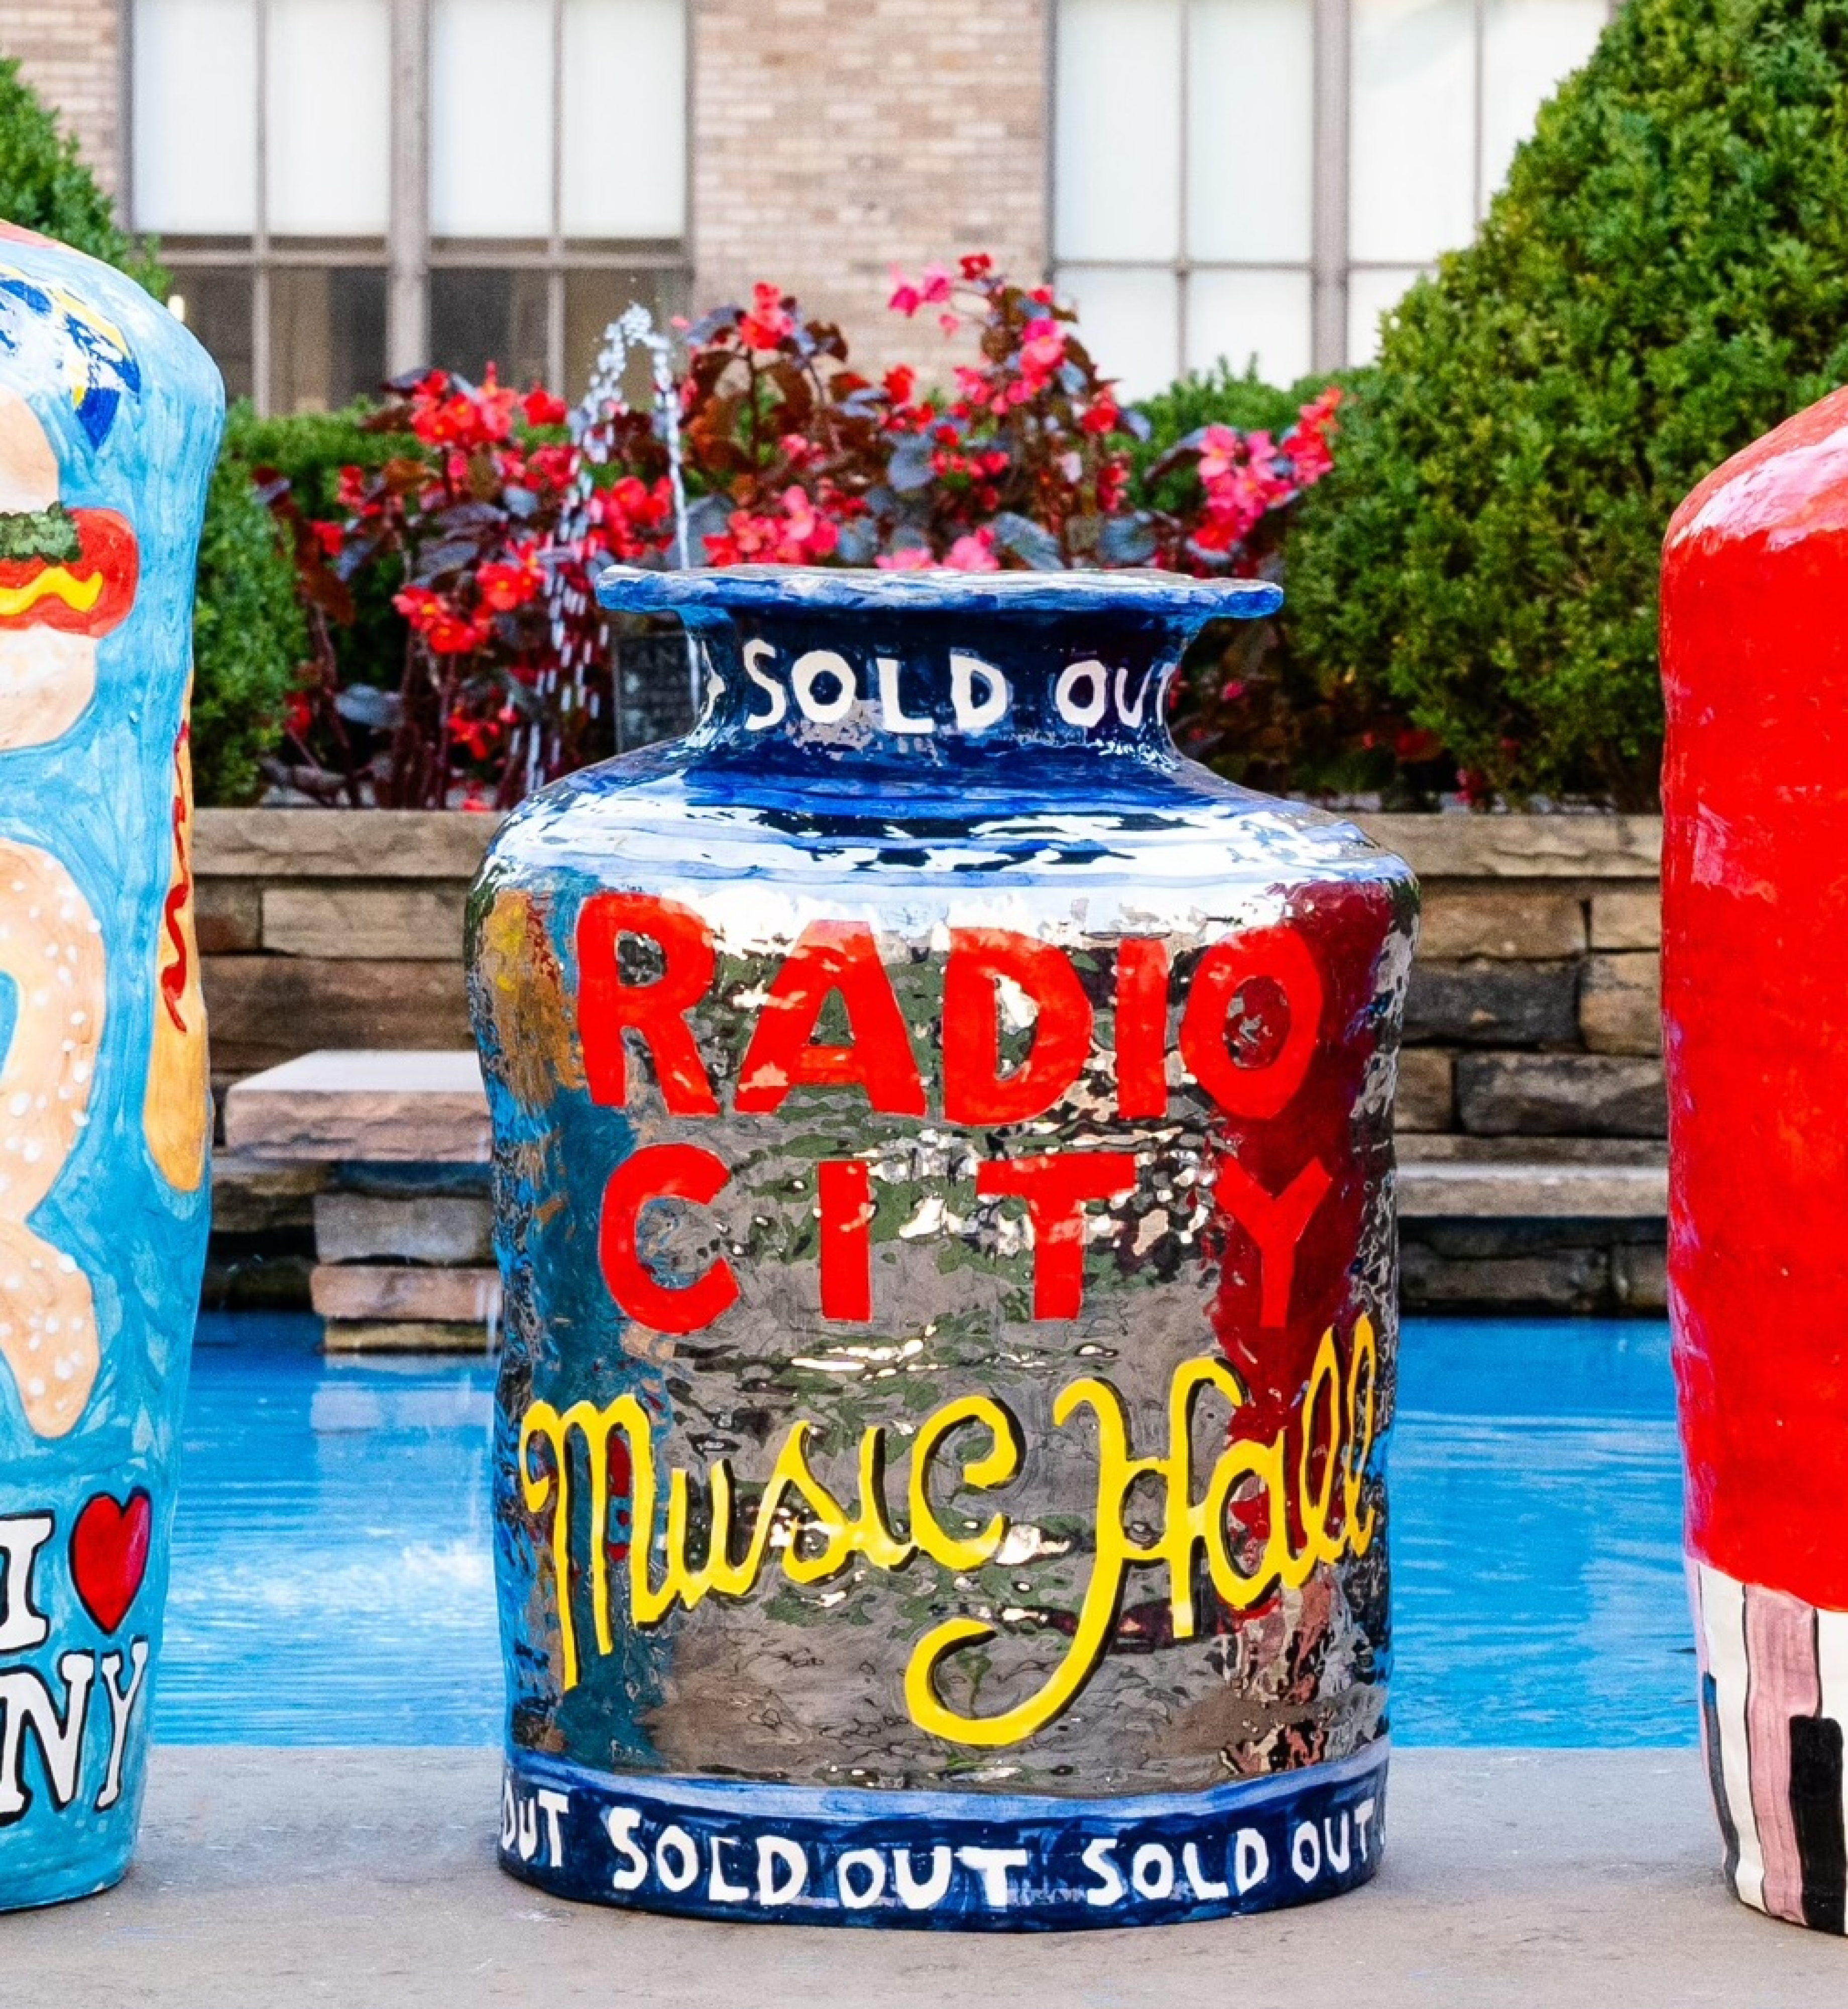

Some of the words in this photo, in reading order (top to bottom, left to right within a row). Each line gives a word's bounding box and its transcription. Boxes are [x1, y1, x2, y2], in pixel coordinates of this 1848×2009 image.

[743, 638, 1007, 734] SOLD
[575, 889, 1325, 1125] RADIO
[598, 1143, 1332, 1334] CITY
[521, 1392, 1018, 1690] Music
[904, 1312, 1376, 1745] Hall
[0, 1636, 149, 1827] NY
[502, 1778, 569, 1867] OUT
[608, 1804, 808, 1907] SOLD
[837, 1846, 1033, 1910] OUT
[1081, 1826, 1269, 1907] SOLD
[1291, 1797, 1375, 1884] OUT
